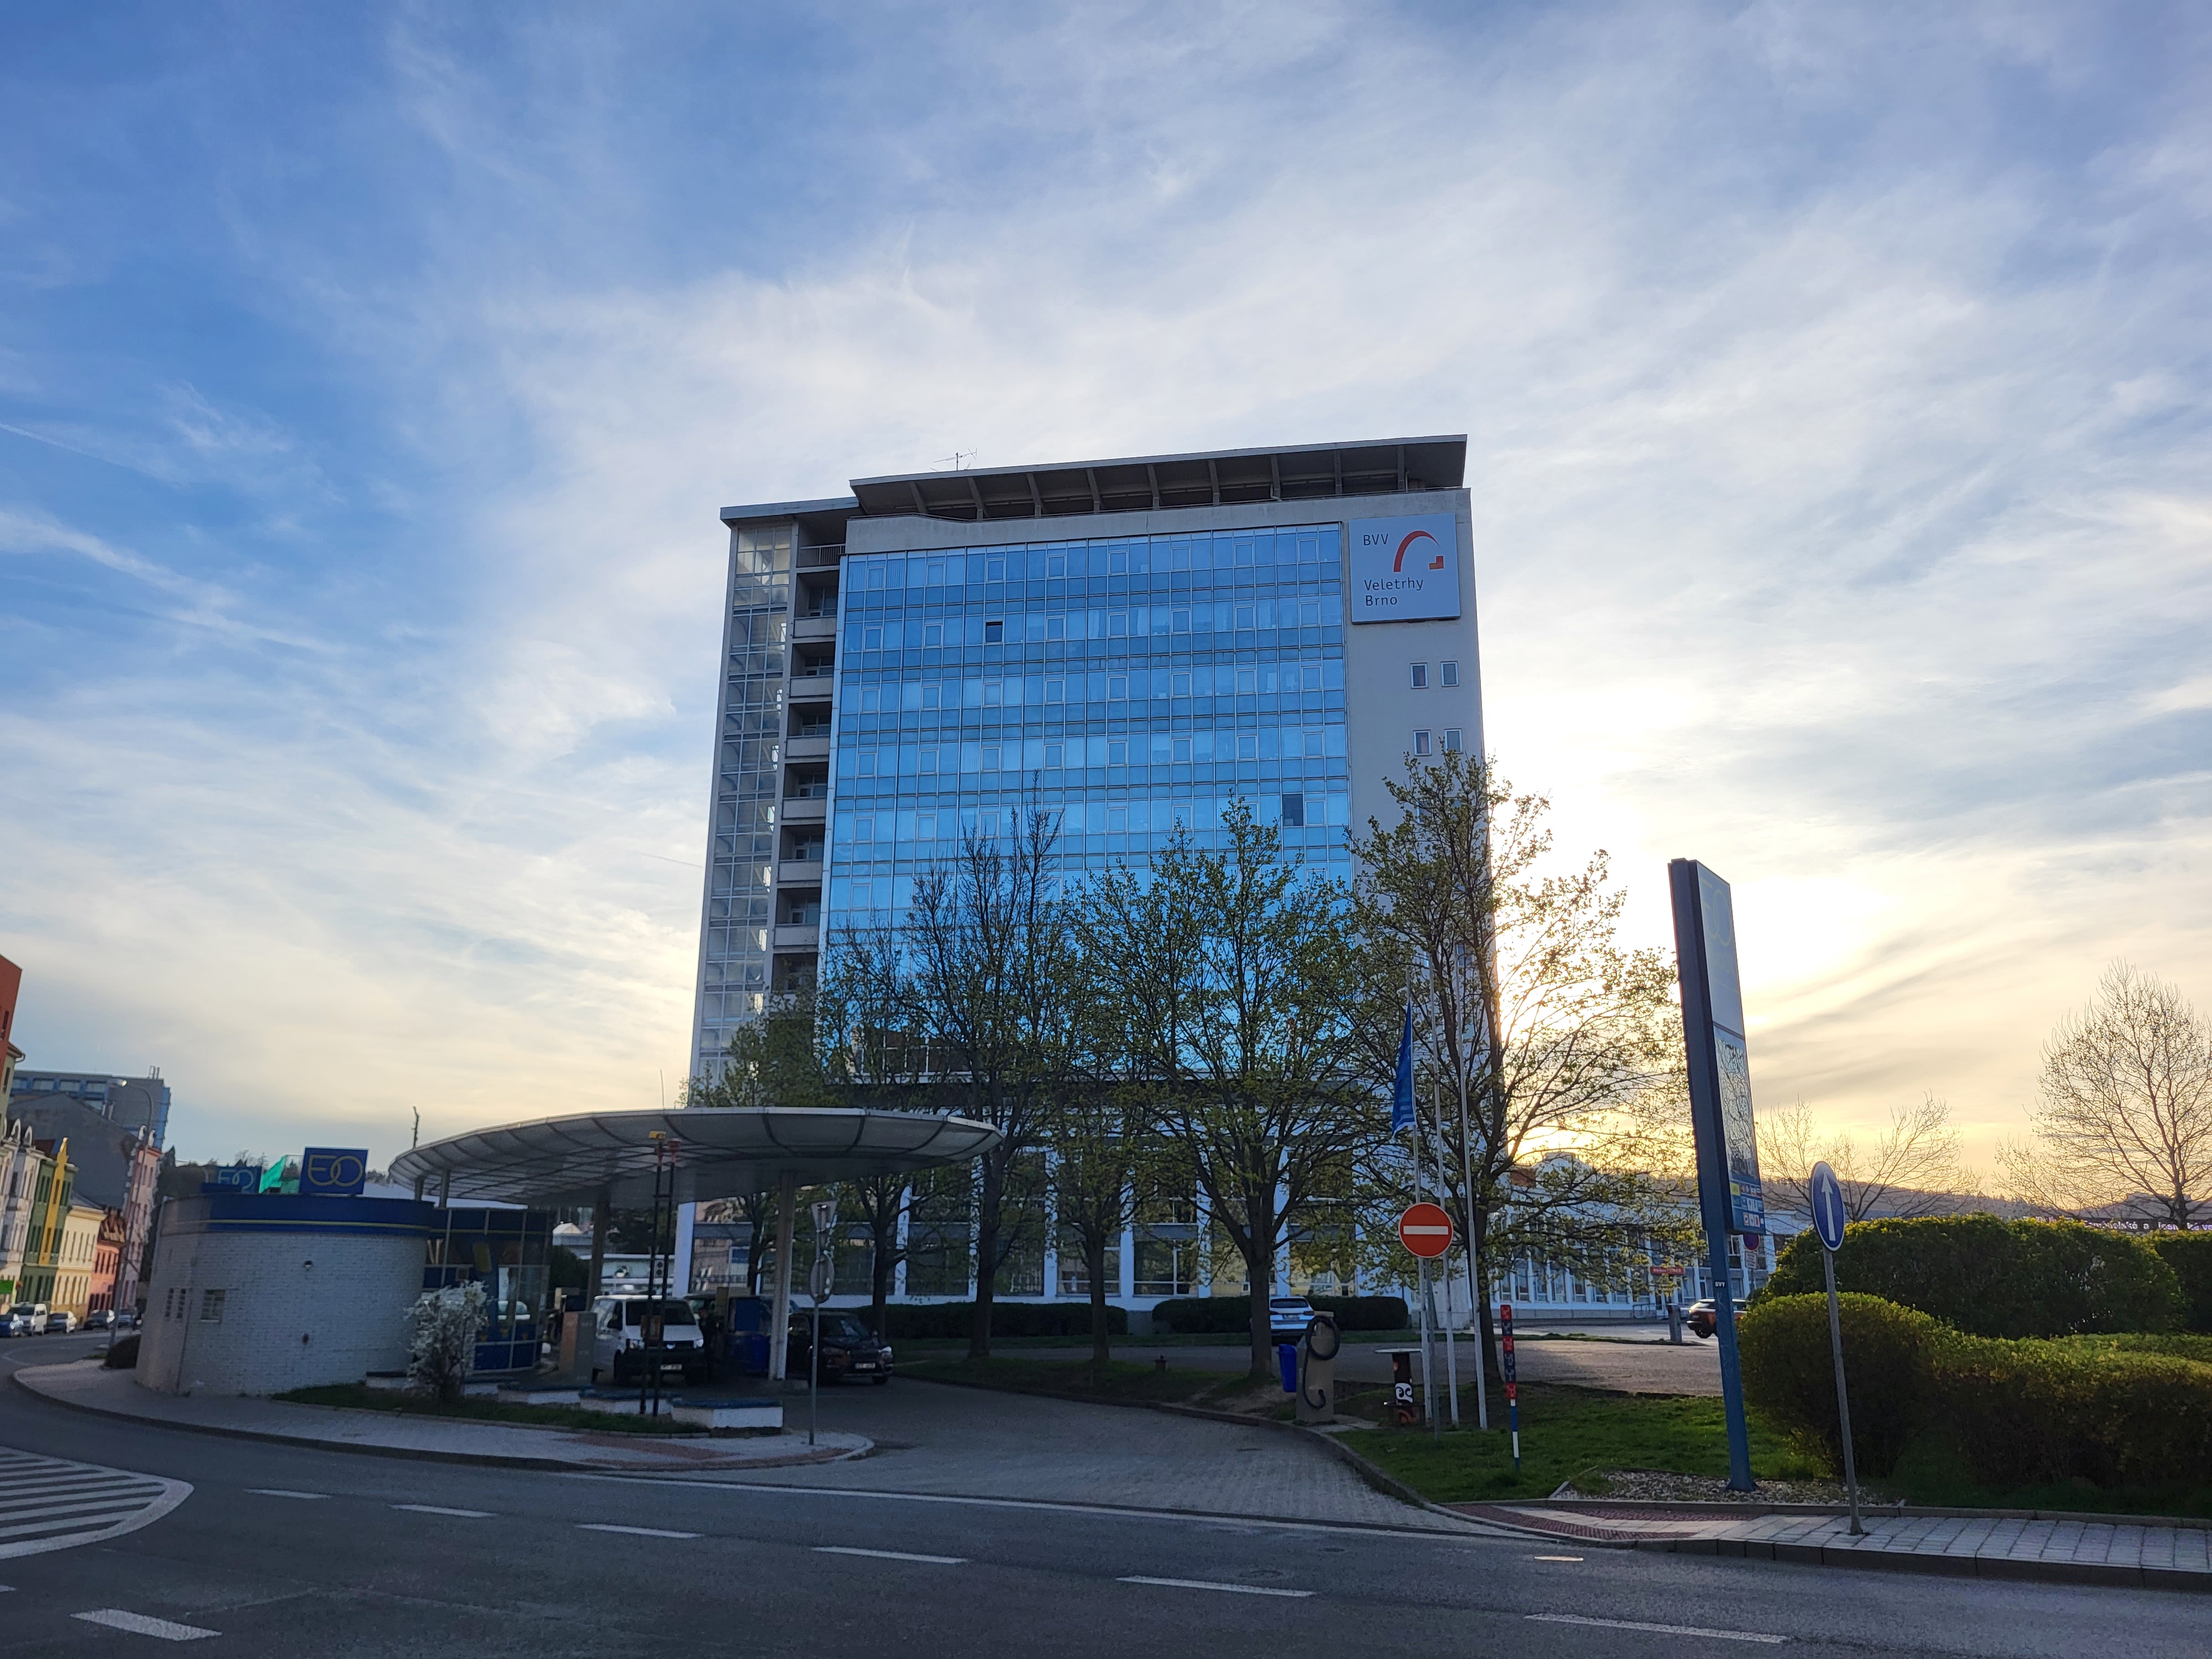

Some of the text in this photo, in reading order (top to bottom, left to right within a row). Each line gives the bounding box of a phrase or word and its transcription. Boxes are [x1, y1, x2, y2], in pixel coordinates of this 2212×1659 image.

[1363, 533, 1389, 546] BVV
[1364, 577, 1423, 591] Veletrhy
[1365, 595, 1397, 606] Brno
